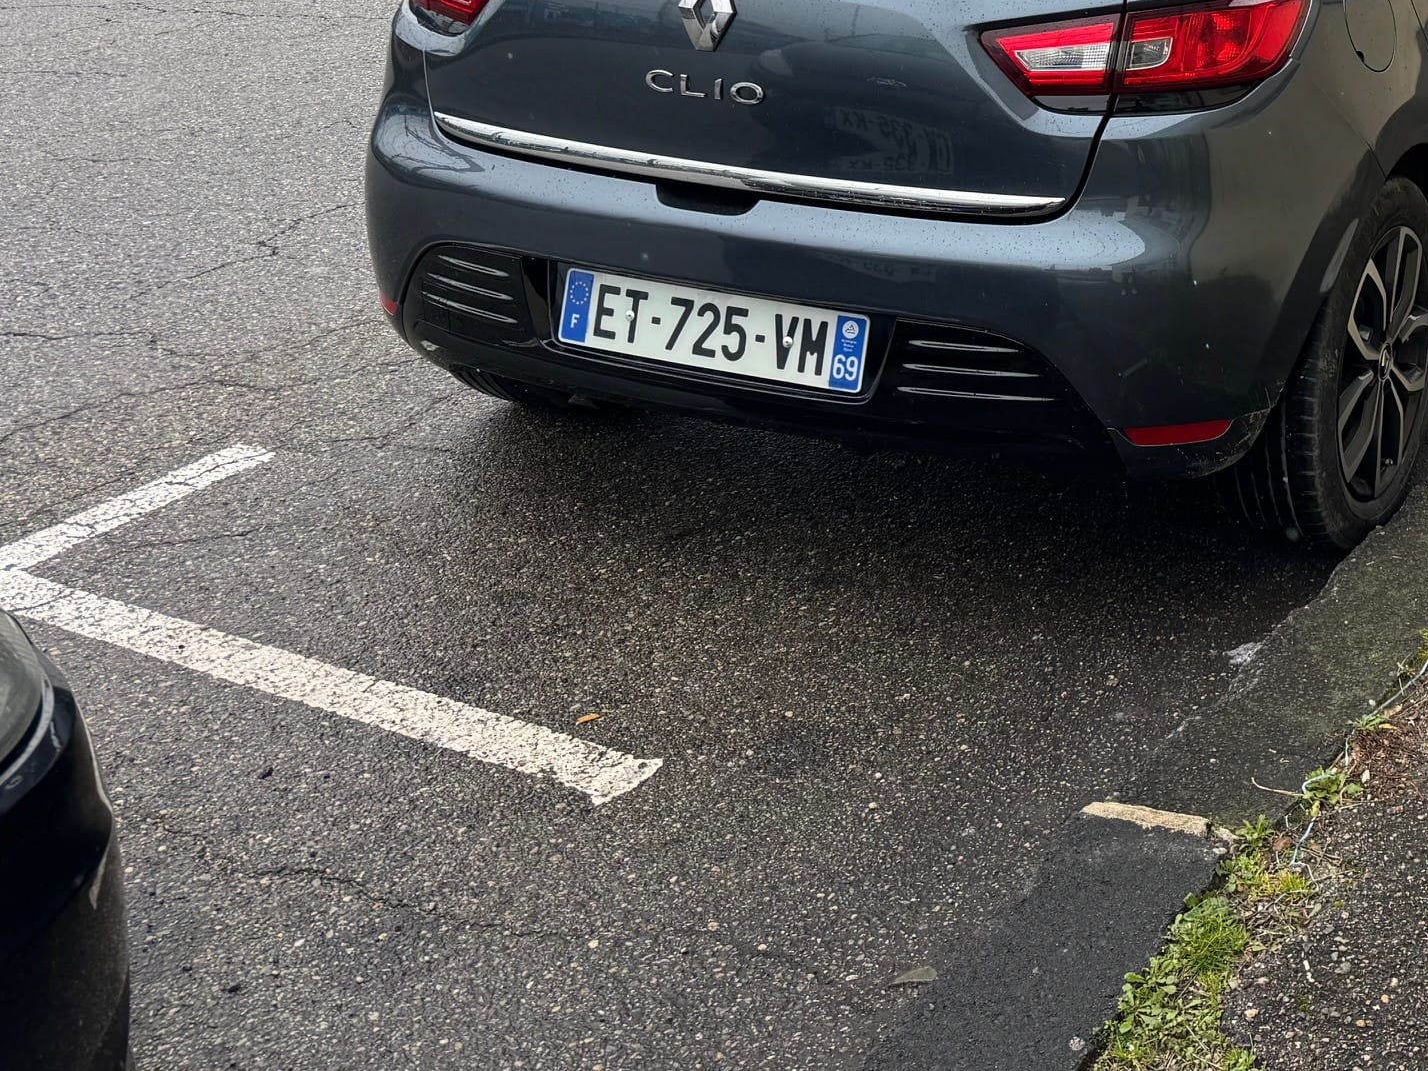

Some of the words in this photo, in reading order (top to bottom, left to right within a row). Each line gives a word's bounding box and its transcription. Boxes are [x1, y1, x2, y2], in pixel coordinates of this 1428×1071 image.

[645, 69, 765, 105] CLIO
[569, 313, 580, 329] F
[592, 283, 830, 377] ET-725-VM
[832, 353, 859, 382] 69
